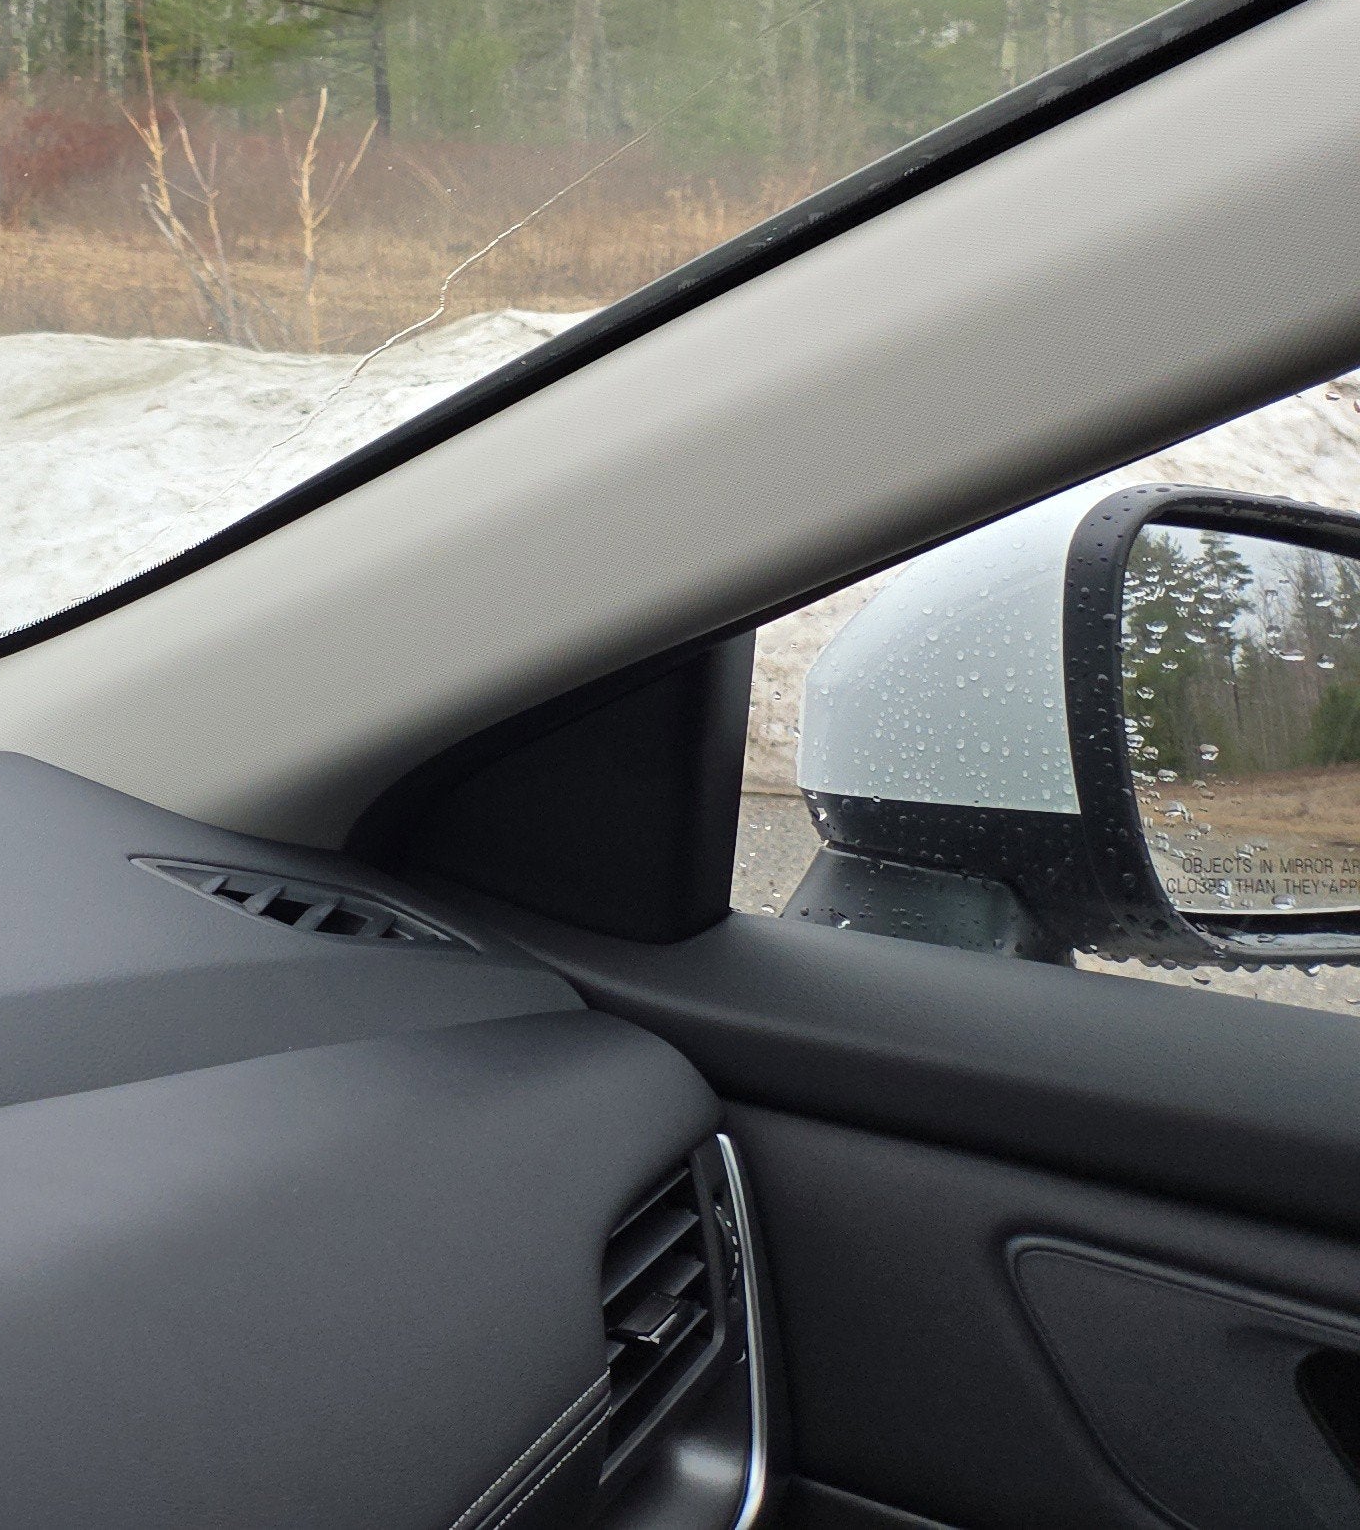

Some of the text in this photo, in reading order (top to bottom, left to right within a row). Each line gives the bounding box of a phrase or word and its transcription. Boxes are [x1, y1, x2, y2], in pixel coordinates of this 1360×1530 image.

[1181, 856, 1252, 873] OBJECTS
[1260, 858, 1273, 874] IN
[1280, 857, 1334, 874] MIRROR
[1234, 878, 1276, 894] THAN
[1283, 878, 1319, 894] THEY
